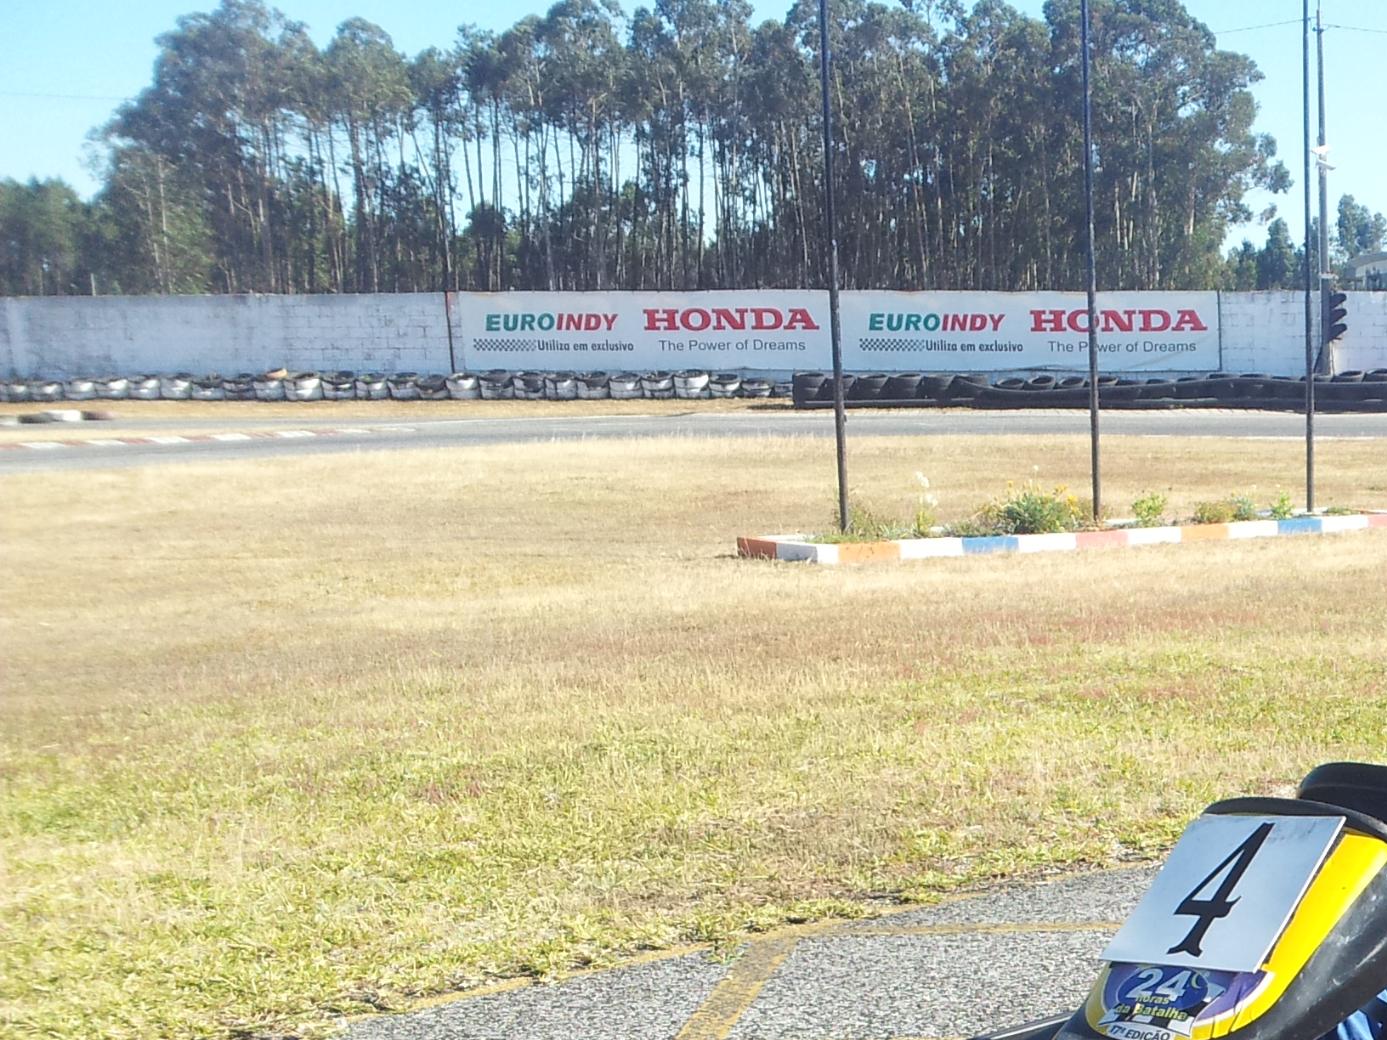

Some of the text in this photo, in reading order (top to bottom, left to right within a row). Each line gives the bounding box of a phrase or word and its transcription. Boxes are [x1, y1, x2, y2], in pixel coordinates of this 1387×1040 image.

[485, 313, 619, 331] EUROINDY
[643, 308, 820, 331] HONDA
[869, 313, 1005, 332] EUROINDY
[1029, 309, 1208, 332] HONDA
[537, 339, 634, 352] Utiliza em exclusivo
[658, 339, 806, 352] The Power of Dreams
[925, 340, 1024, 353] Utiliza em exclusivo
[1048, 340, 1197, 353] The Pwer of Dreams
[1167, 822, 1275, 957] 4
[1125, 968, 1192, 1001] 24
[1115, 1003, 1189, 1021] da Batalha
